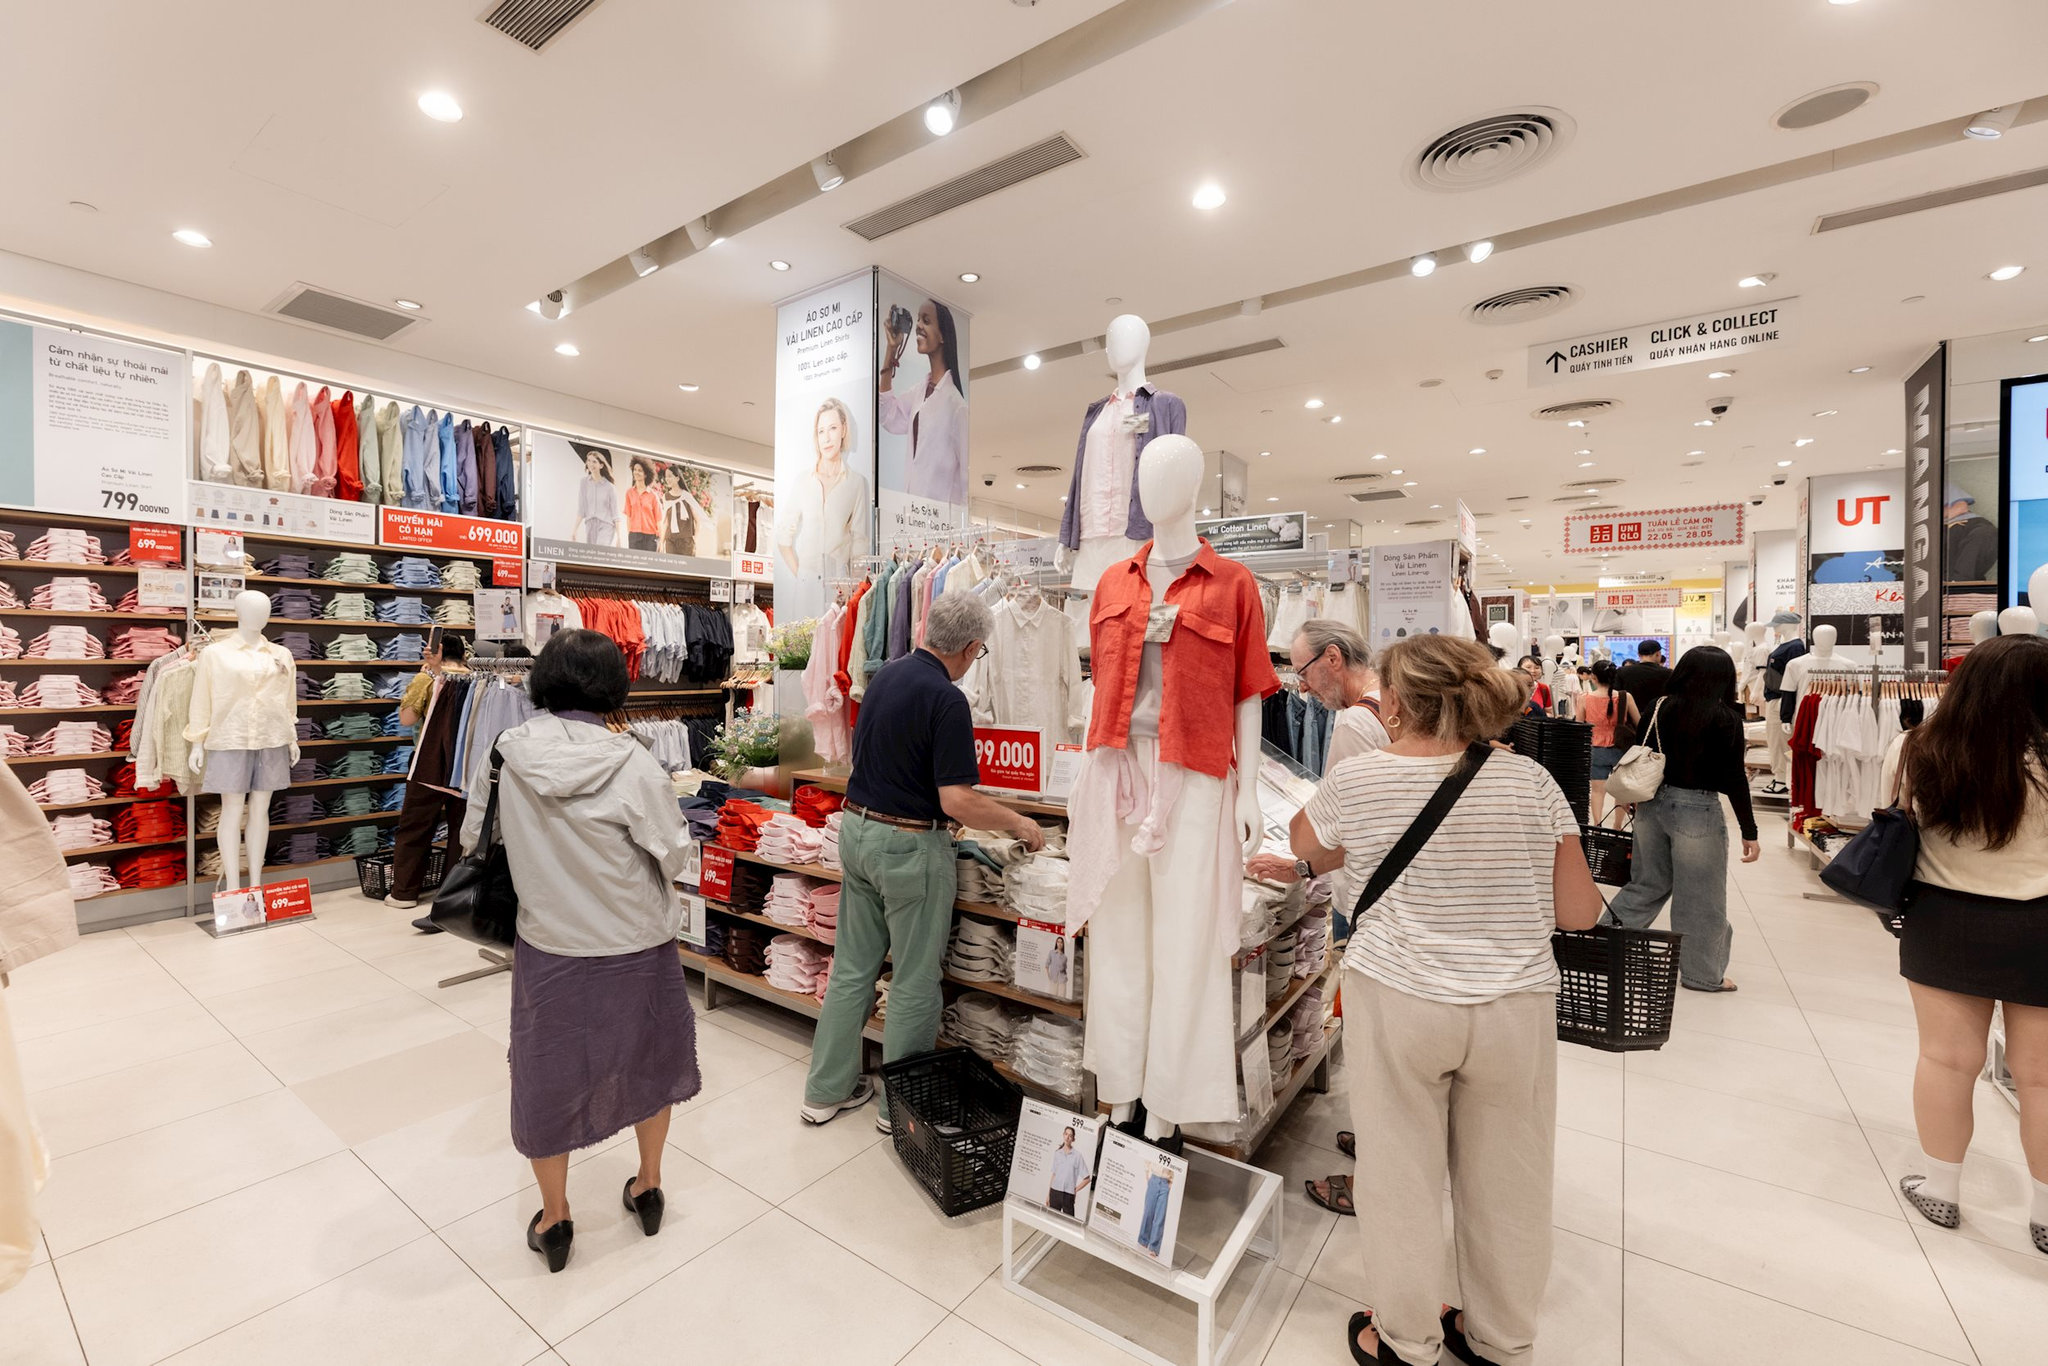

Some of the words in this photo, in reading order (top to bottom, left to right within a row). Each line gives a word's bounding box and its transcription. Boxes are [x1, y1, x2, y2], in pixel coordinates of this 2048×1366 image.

[800, 324, 824, 341] LINEN
[826, 318, 843, 333] CAO
[1650, 324, 1691, 344] CLICK
[1697, 322, 1707, 336] &
[1712, 308, 1778, 333] COLLECT
[1741, 330, 1780, 345] ONLINE
[1570, 336, 1628, 358] CASHIER
[1912, 383, 1930, 604] MANGA
[101, 490, 139, 511] 799
[139, 504, 170, 514] 000VND
[1837, 495, 1891, 527] UT
[468, 525, 518, 545] 699.000
[1220, 524, 1245, 534] Cotton
[1246, 523, 1268, 532] Linen
[1647, 532, 1673, 541] 22.05
[1686, 530, 1713, 539] 28.05
[137, 538, 156, 549] 699
[538, 545, 565, 556] LINEN
[704, 869, 717, 883] 699
[271, 897, 288, 909] 699
[1072, 1117, 1084, 1129] 599
[1158, 1153, 1172, 1167] 999
